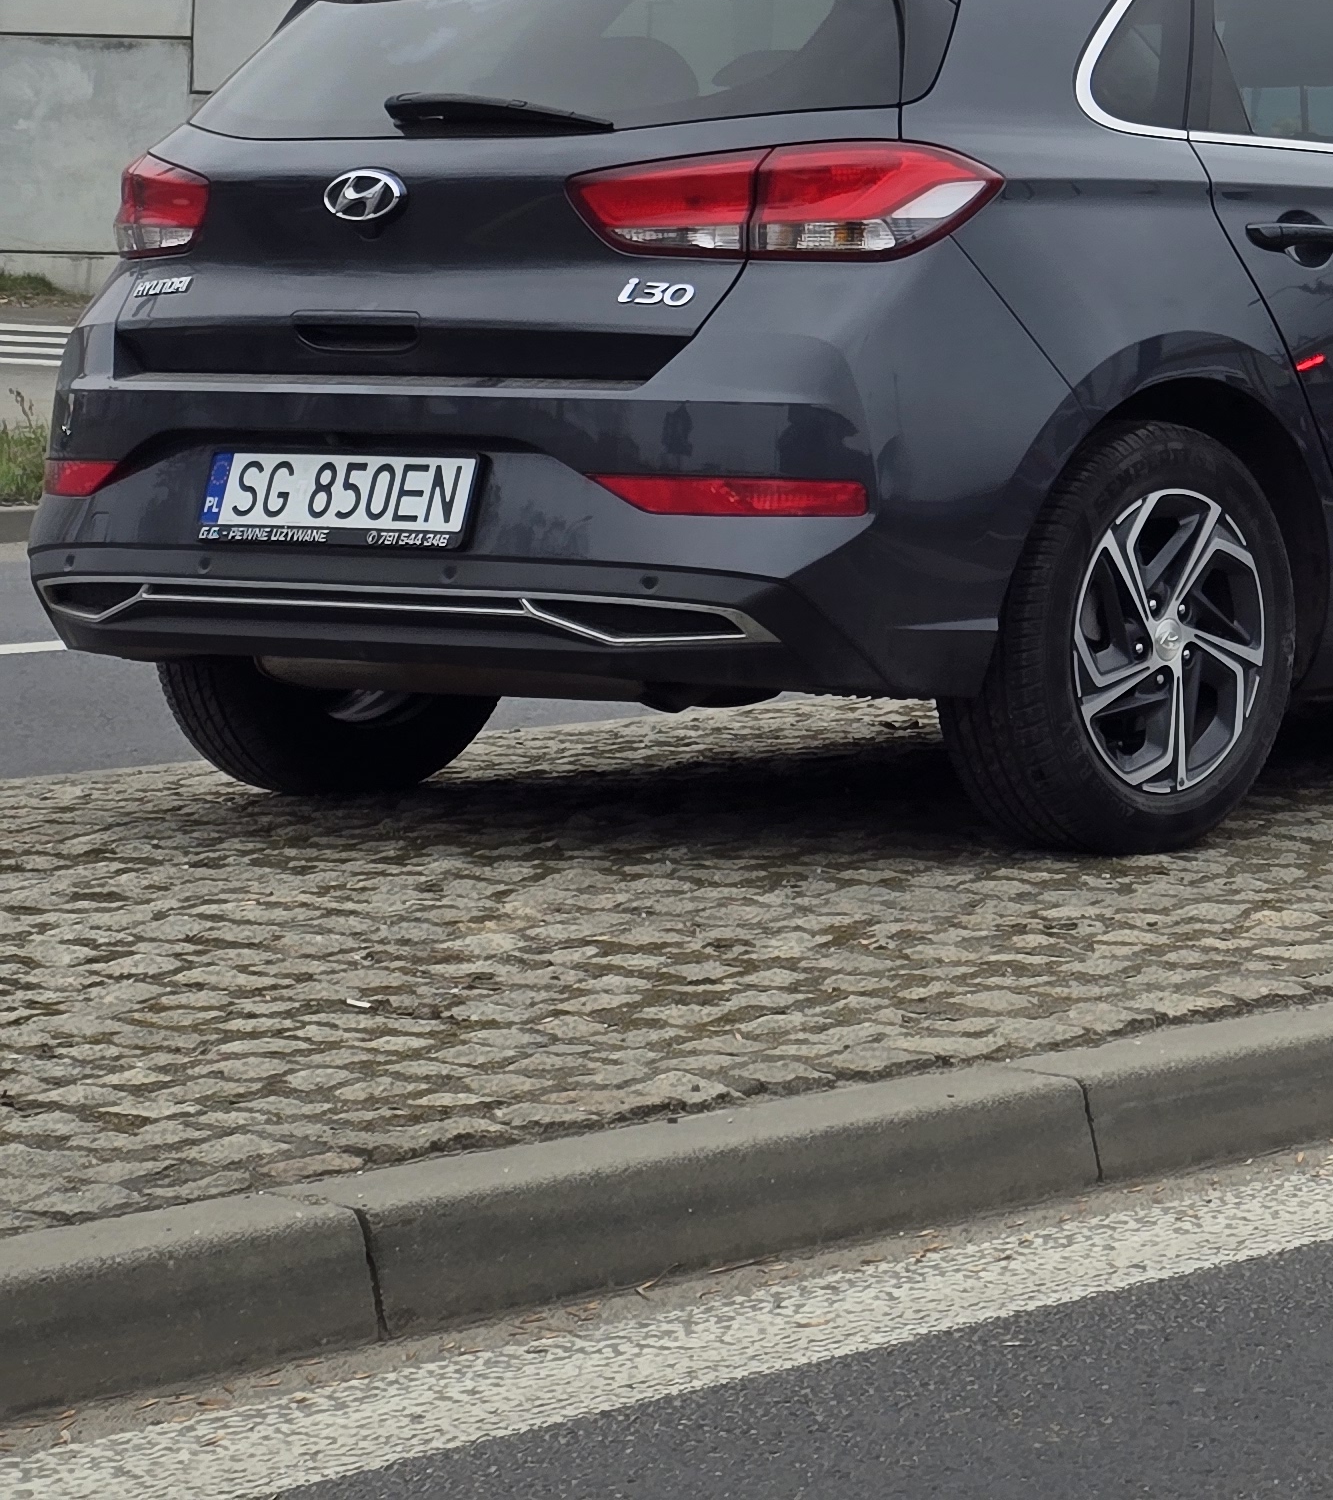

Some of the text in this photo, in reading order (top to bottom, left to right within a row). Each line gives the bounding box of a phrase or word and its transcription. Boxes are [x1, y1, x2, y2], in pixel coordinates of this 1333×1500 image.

[133, 276, 193, 297] HYUNDAI
[617, 277, 695, 306] i30
[231, 460, 463, 524] SG 850EN
[204, 496, 219, 513] PL
[228, 527, 272, 541] PEWNE
